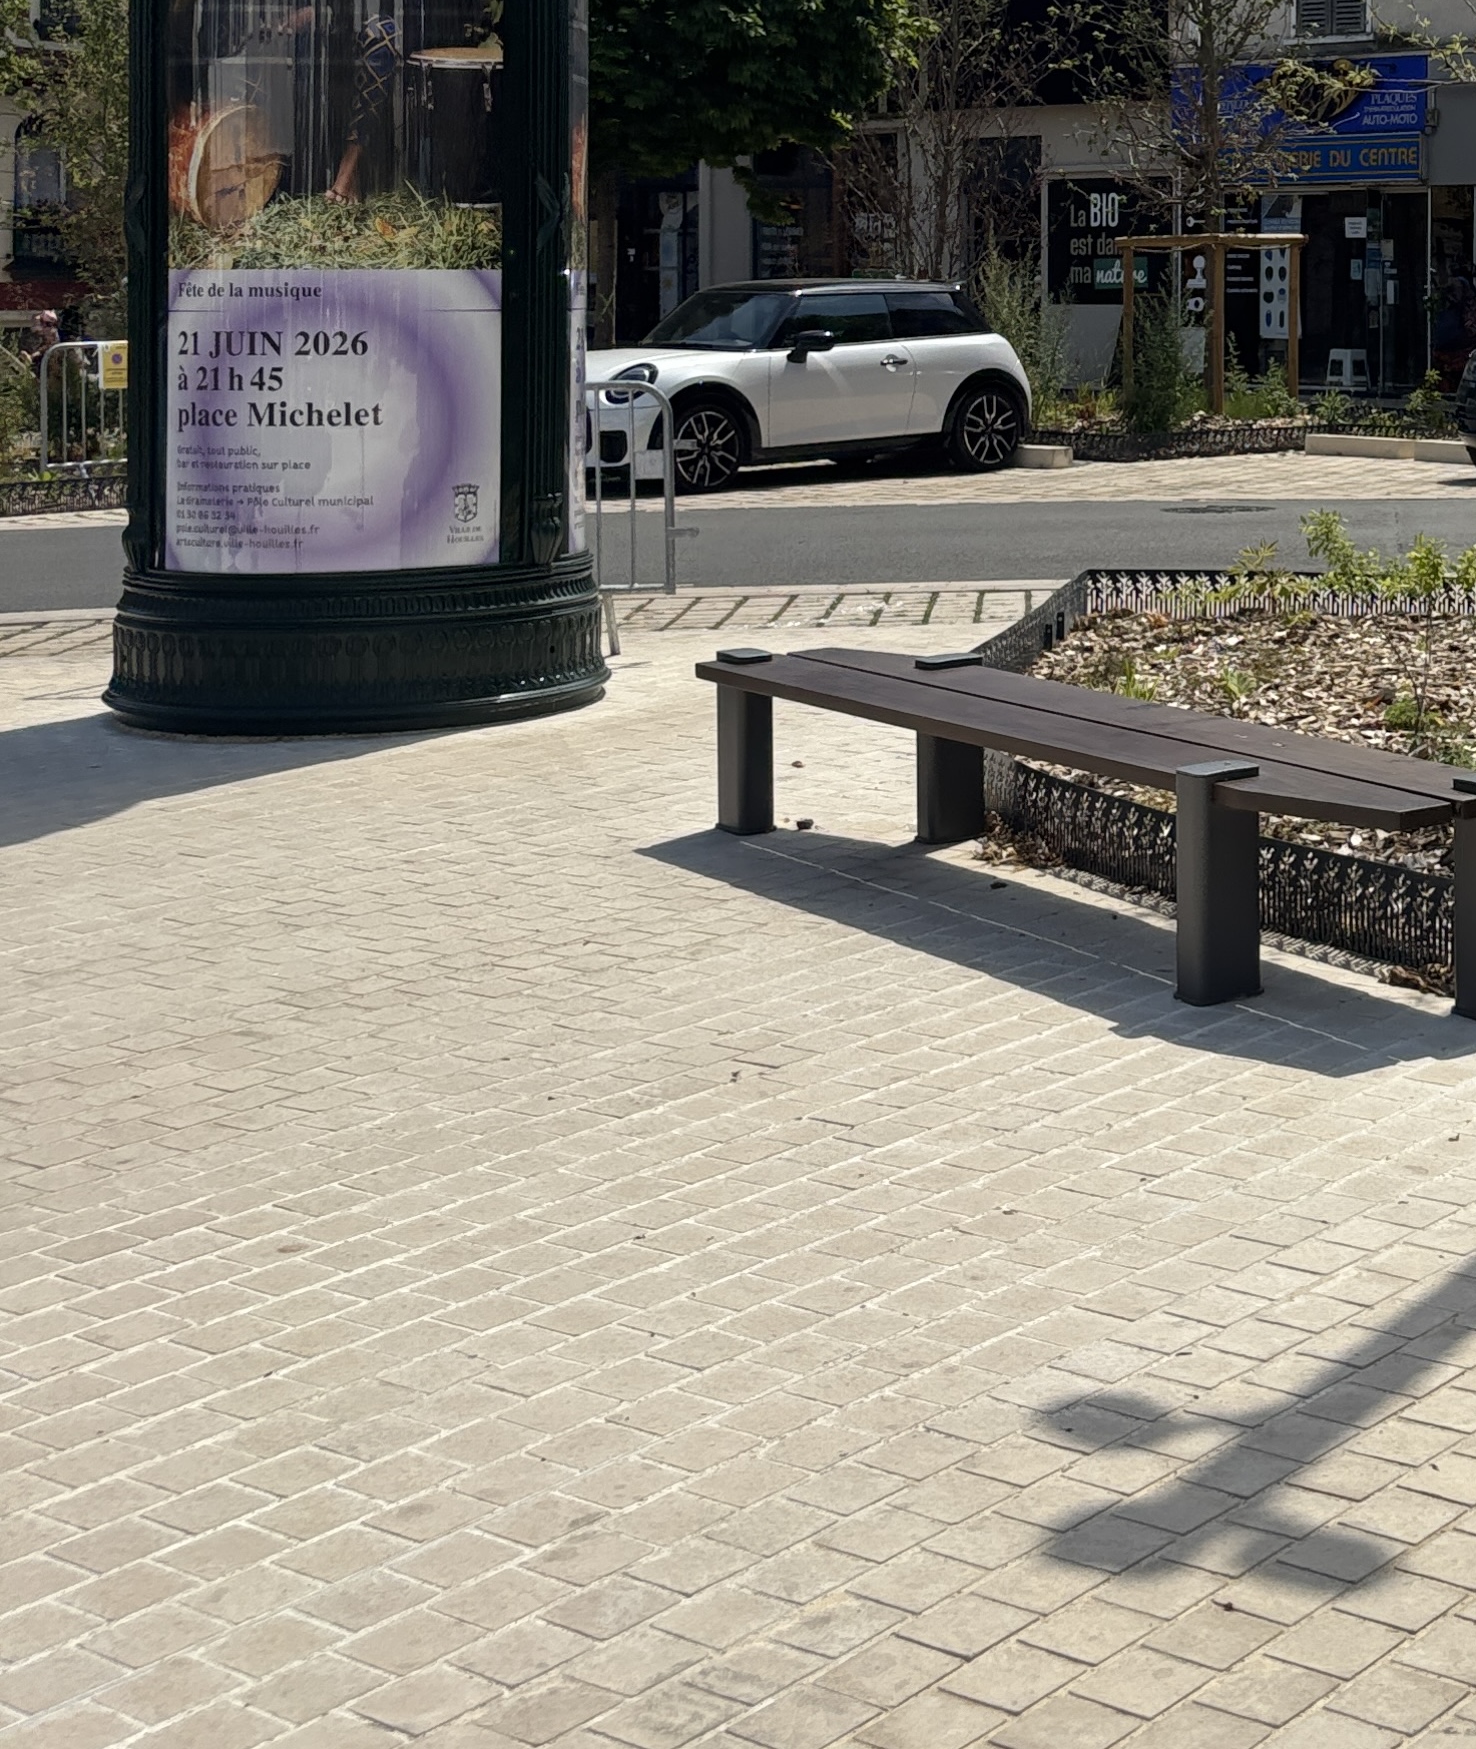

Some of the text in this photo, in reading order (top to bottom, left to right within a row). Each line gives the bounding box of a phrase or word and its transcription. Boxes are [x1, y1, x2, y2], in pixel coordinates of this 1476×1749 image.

[1370, 93, 1417, 105] PLAQUES
[1361, 112, 1418, 125] AUTO-MOTO
[1329, 150, 1350, 168] DU
[1359, 146, 1418, 167] CENTRE
[1069, 192, 1119, 227] La BIO
[1069, 234, 1094, 256] est
[1069, 266, 1092, 284] ma
[178, 281, 322, 301] Fête de la musique
[178, 330, 369, 359] 21 JUIN 2026
[177, 365, 284, 392] à 21 h 45
[177, 401, 384, 432] place Michelet
[207, 446, 225, 456] tout
[227, 445, 261, 458] public,
[200, 459, 258, 470] restauration
[261, 461, 278, 470] sur
[281, 459, 311, 472] place
[176, 481, 280, 494] Informations pratiques
[247, 496, 269, 507] Pôle
[271, 496, 315, 507] Culturel
[318, 495, 374, 508] municipal
